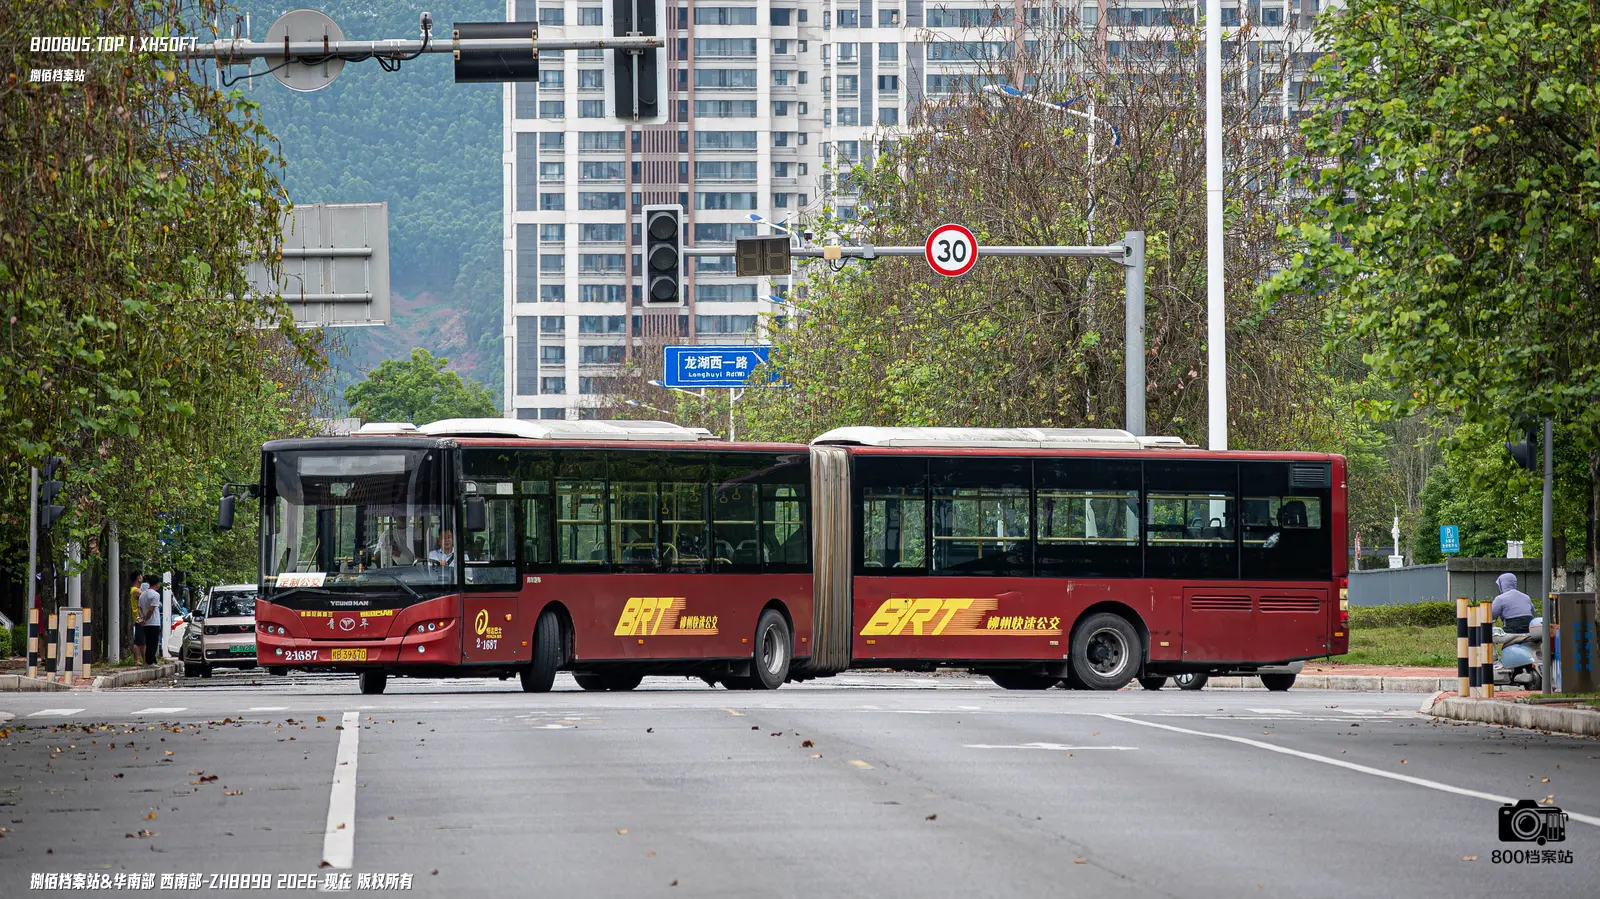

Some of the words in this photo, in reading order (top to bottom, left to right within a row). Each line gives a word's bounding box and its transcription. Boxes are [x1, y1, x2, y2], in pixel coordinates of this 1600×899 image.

[937, 239, 967, 263] 30
[684, 355, 748, 370] 龙湖西一路
[688, 371, 723, 379] Longhuyi
[279, 576, 321, 588] 定制公交
[614, 597, 674, 636] BRT
[860, 598, 974, 636] BRT
[986, 615, 1061, 630] 柳州快速公交
[476, 637, 498, 650] 2-1687
[285, 650, 318, 661] 2-1687
